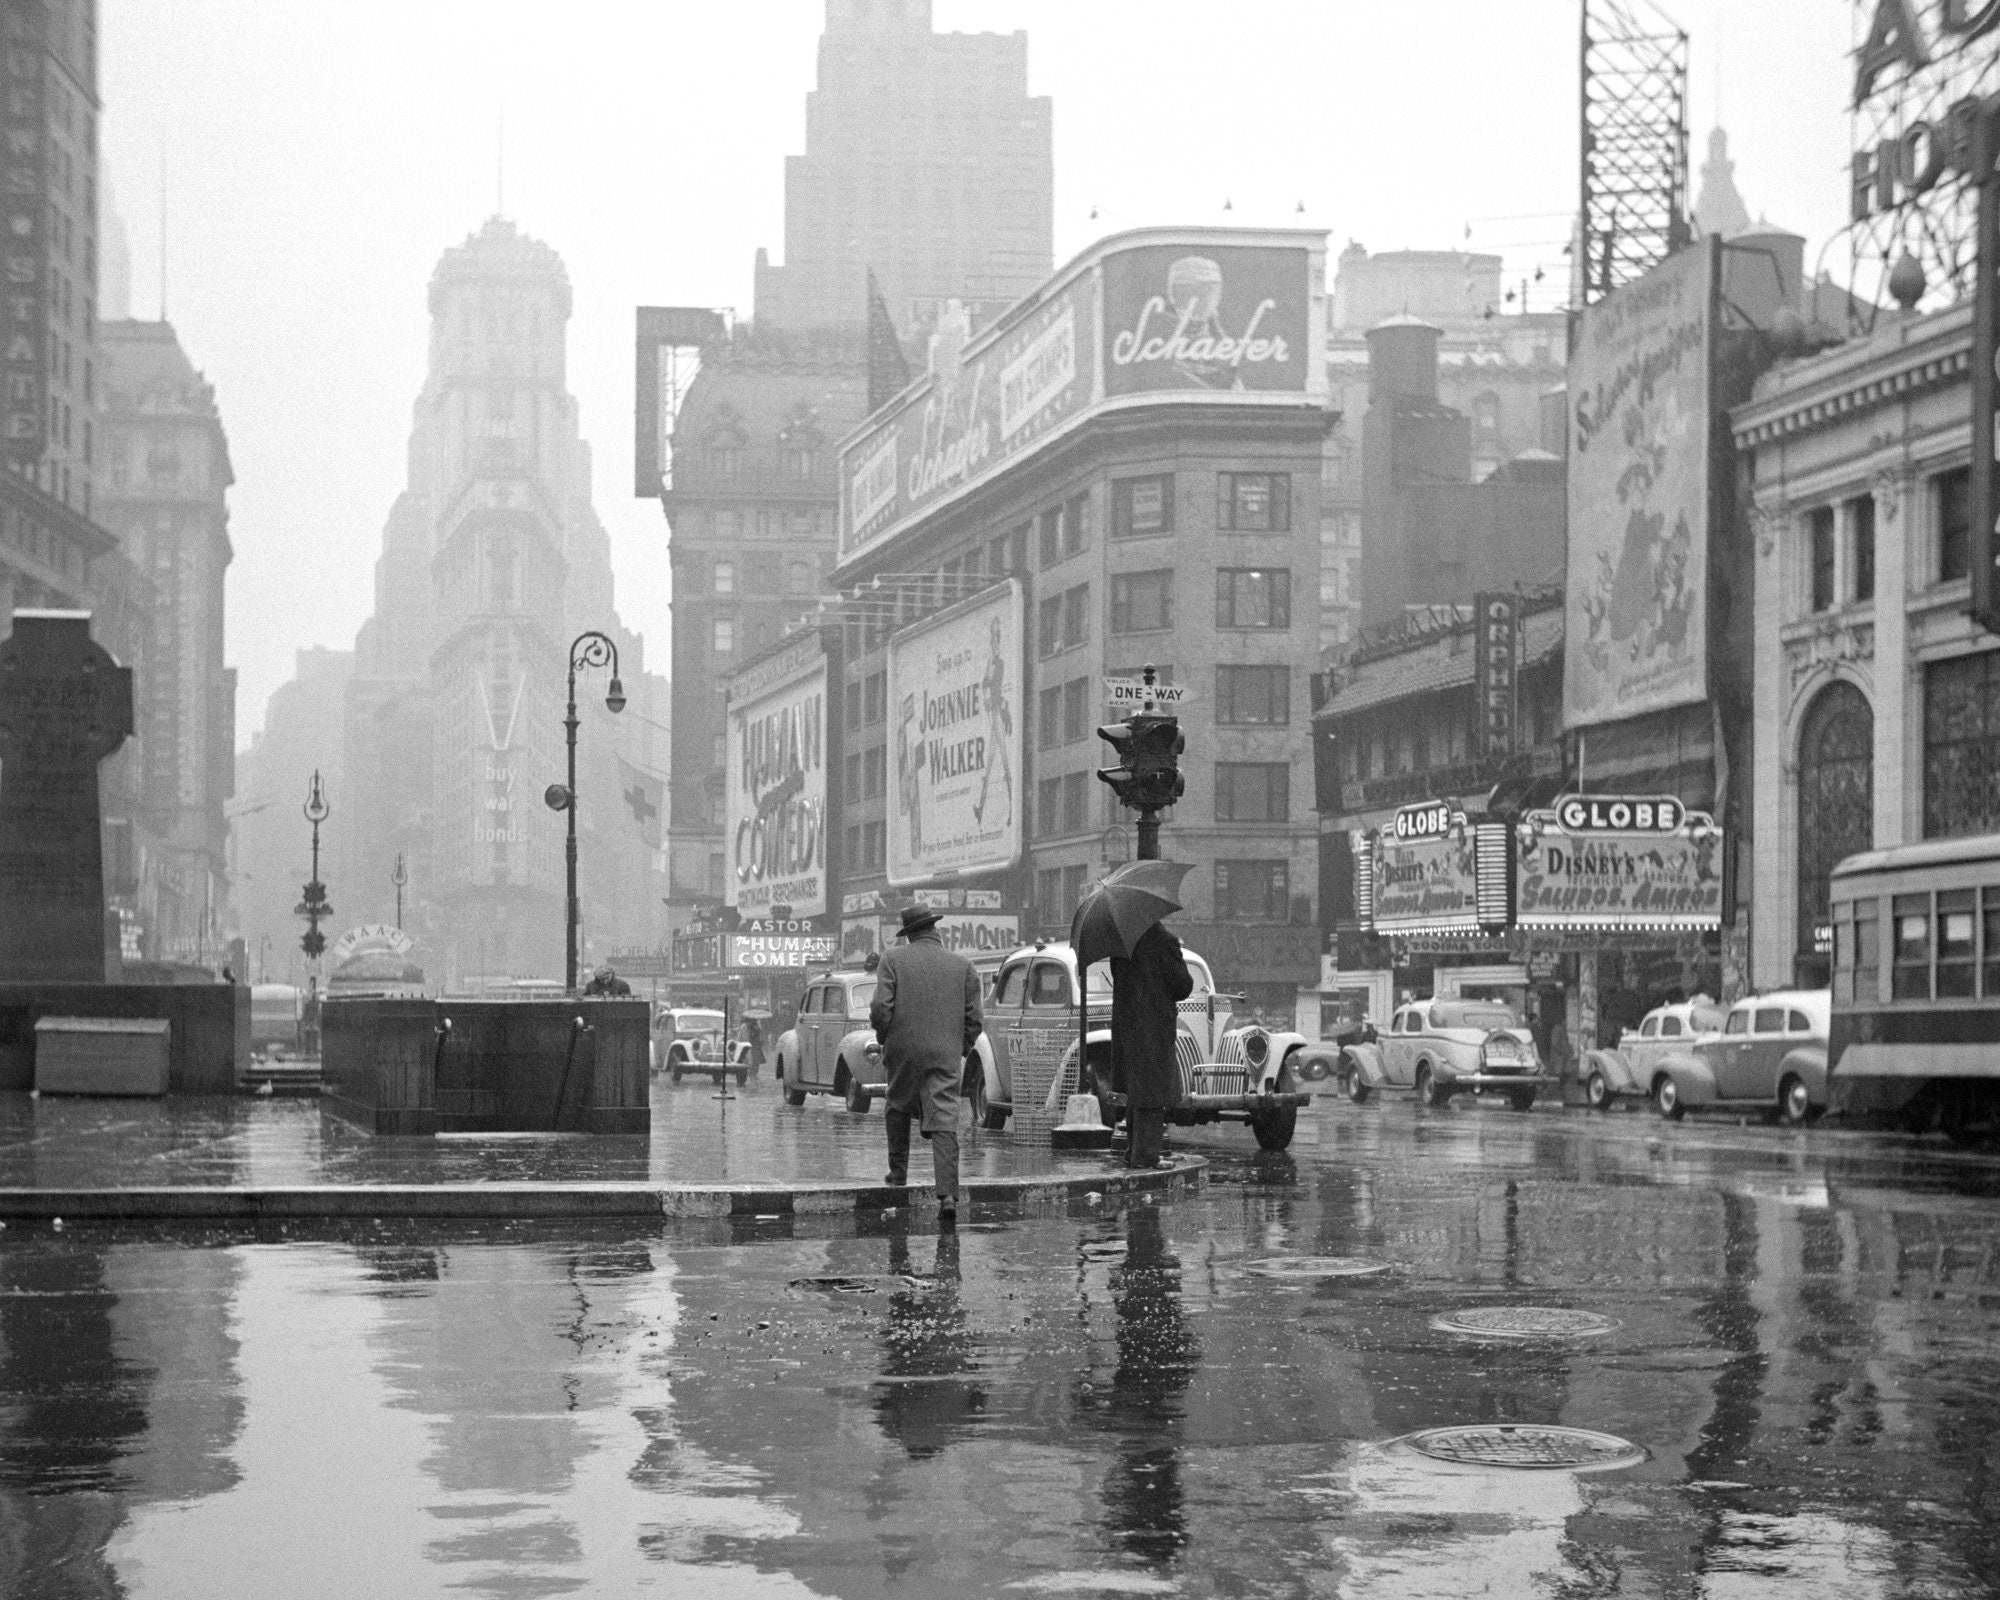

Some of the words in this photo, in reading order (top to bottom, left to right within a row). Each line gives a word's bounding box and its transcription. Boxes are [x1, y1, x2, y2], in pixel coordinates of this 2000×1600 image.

[1112, 296, 1289, 367] Schaefer
[7, 257, 37, 440] STATE
[1488, 601, 1510, 754] ORPHEUM
[920, 683, 979, 734] JOHNNIE
[743, 692, 821, 792] HUMAN
[485, 756, 517, 793] buy
[930, 737, 985, 785] WALKER
[485, 797, 516, 811] war
[1564, 802, 1675, 828] GLOBE
[474, 818, 527, 842] bonds
[1397, 807, 1448, 836] GLOBE
[736, 796, 824, 884] COMEDY
[1571, 838, 1618, 857] WALT
[1548, 847, 1635, 876] DISNEY'S
[344, 926, 402, 944] WAAC
[751, 920, 812, 932] ASTOR
[737, 936, 750, 946] The
[751, 937, 831, 951] HUMAN
[738, 952, 831, 966] COME
